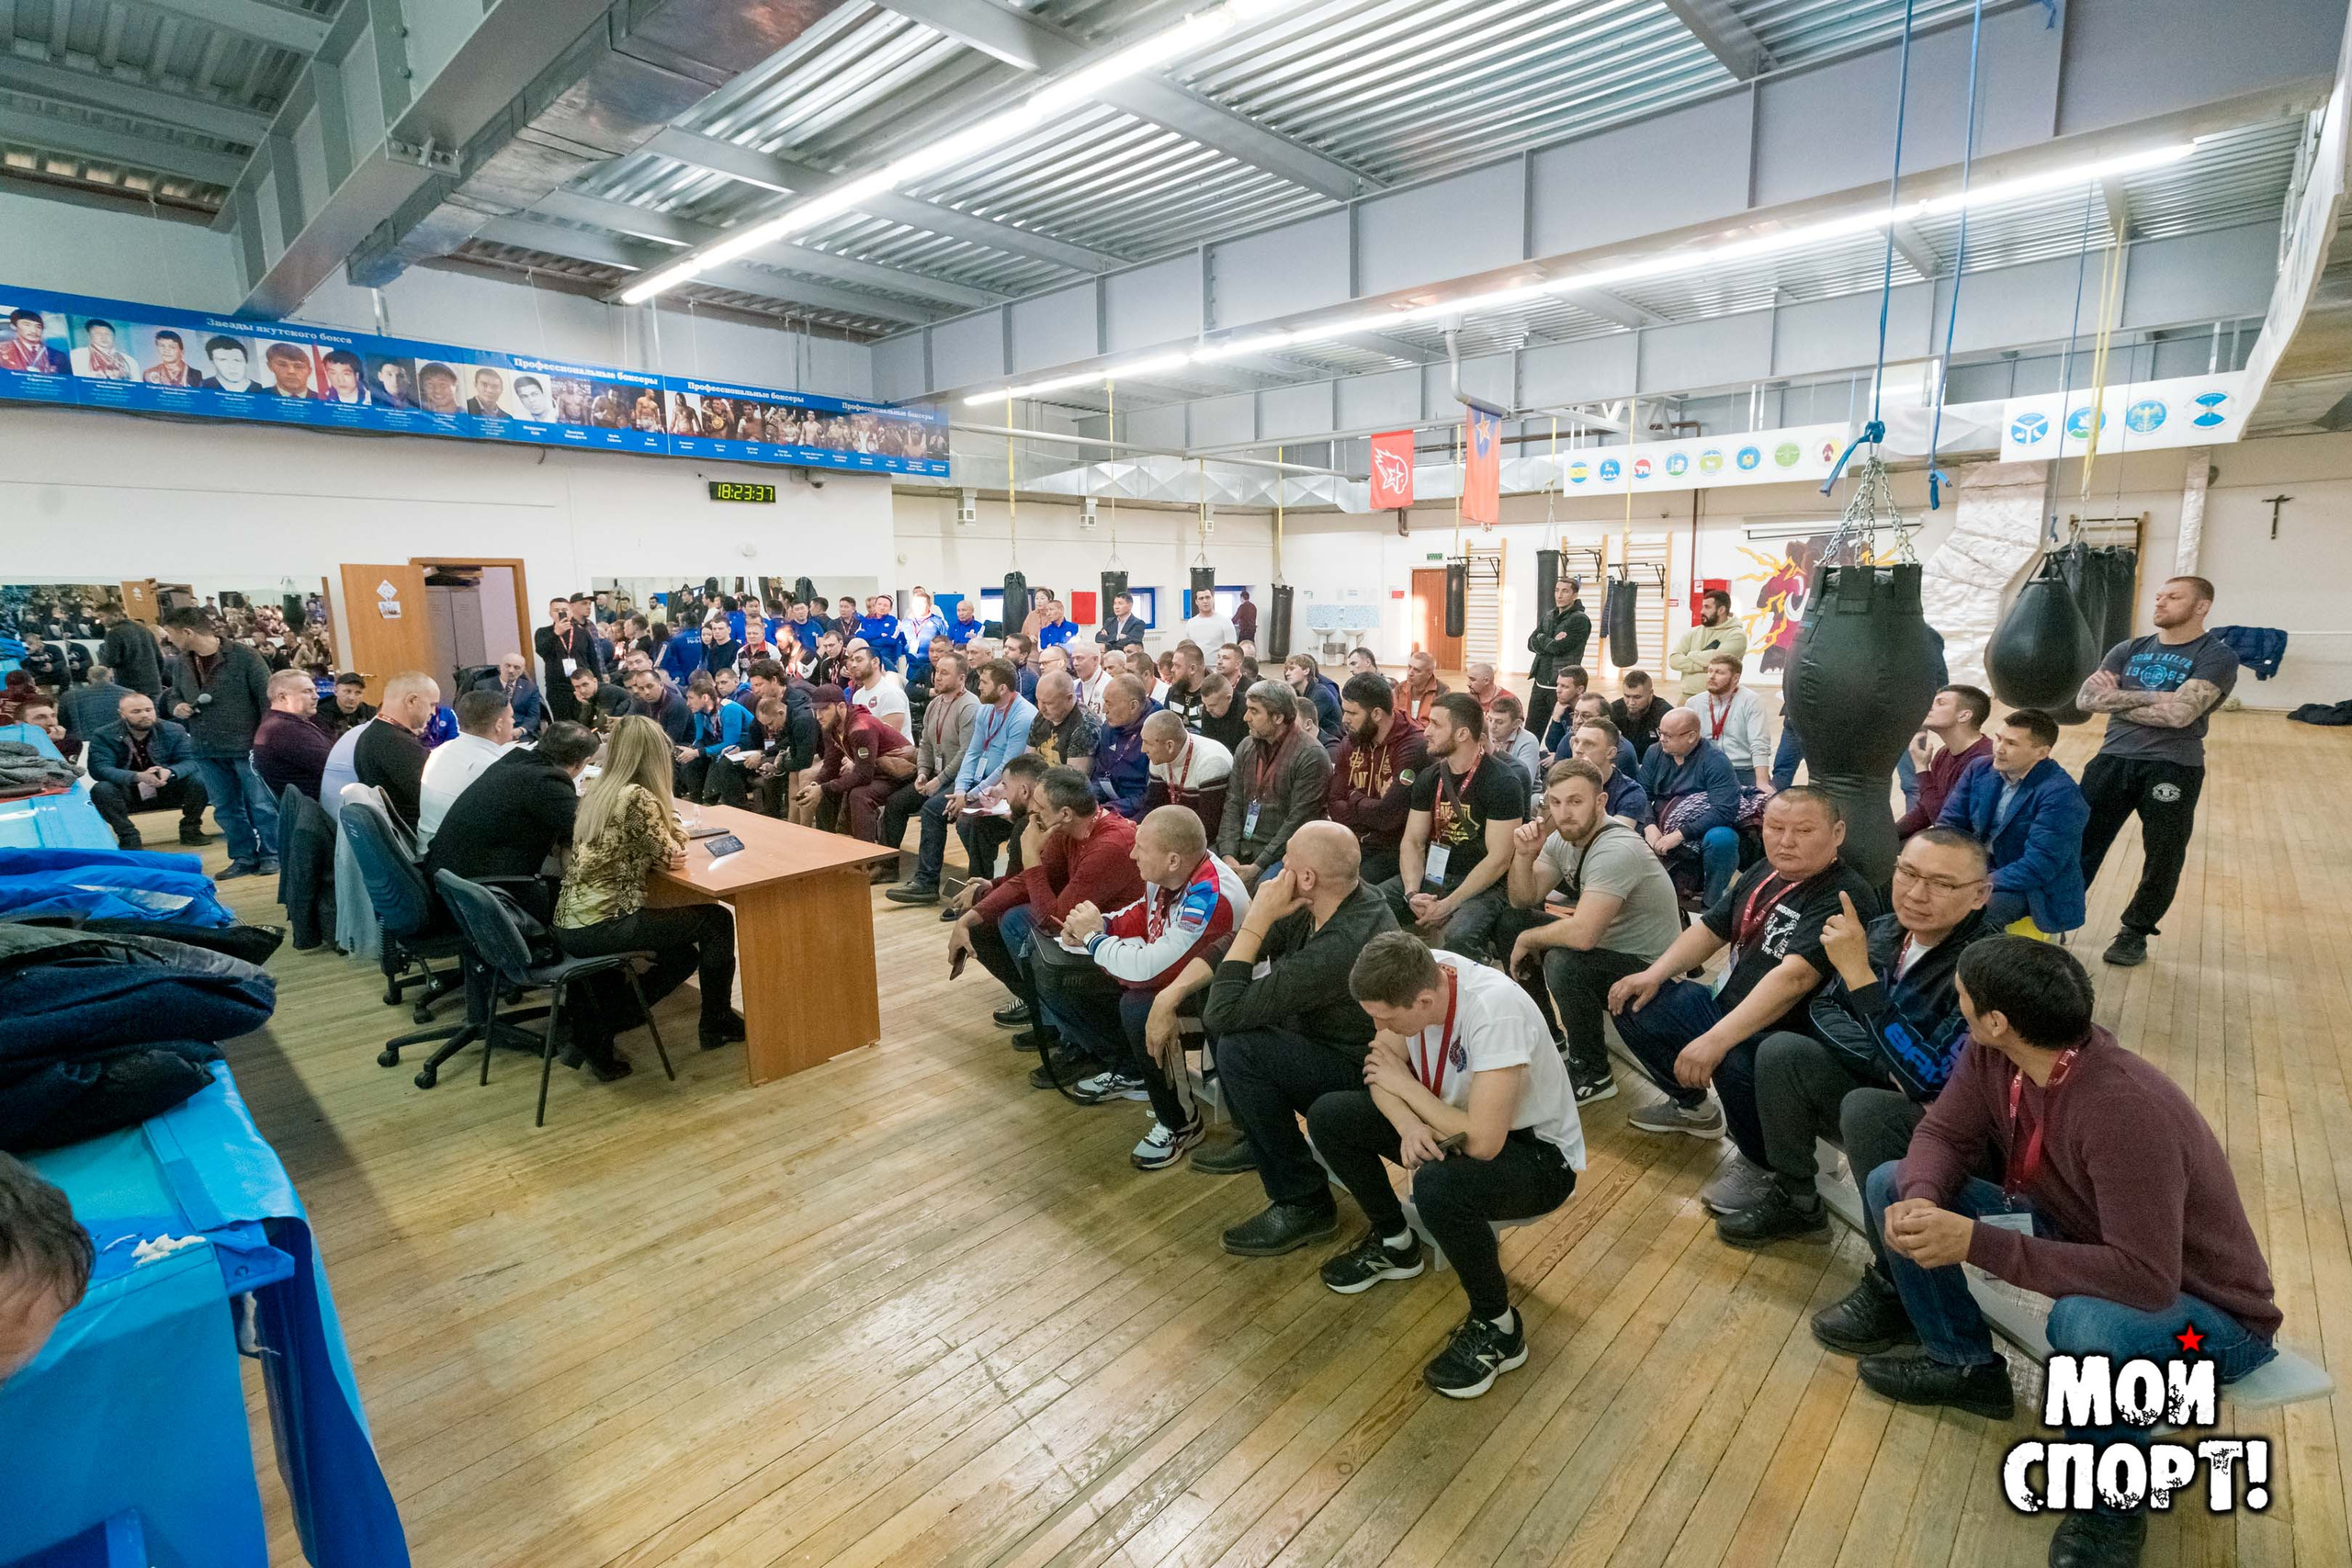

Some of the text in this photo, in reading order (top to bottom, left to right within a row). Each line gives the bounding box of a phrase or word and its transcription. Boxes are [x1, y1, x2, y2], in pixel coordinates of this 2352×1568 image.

[206, 317, 353, 344] Звезды якутского бокса
[514, 358, 659, 386] Профессиональные боксеры
[687, 381, 805, 404] Профессиональные боксеры
[842, 401, 907, 417] Профессиональные
[718, 483, 774, 502] 18:23:37
